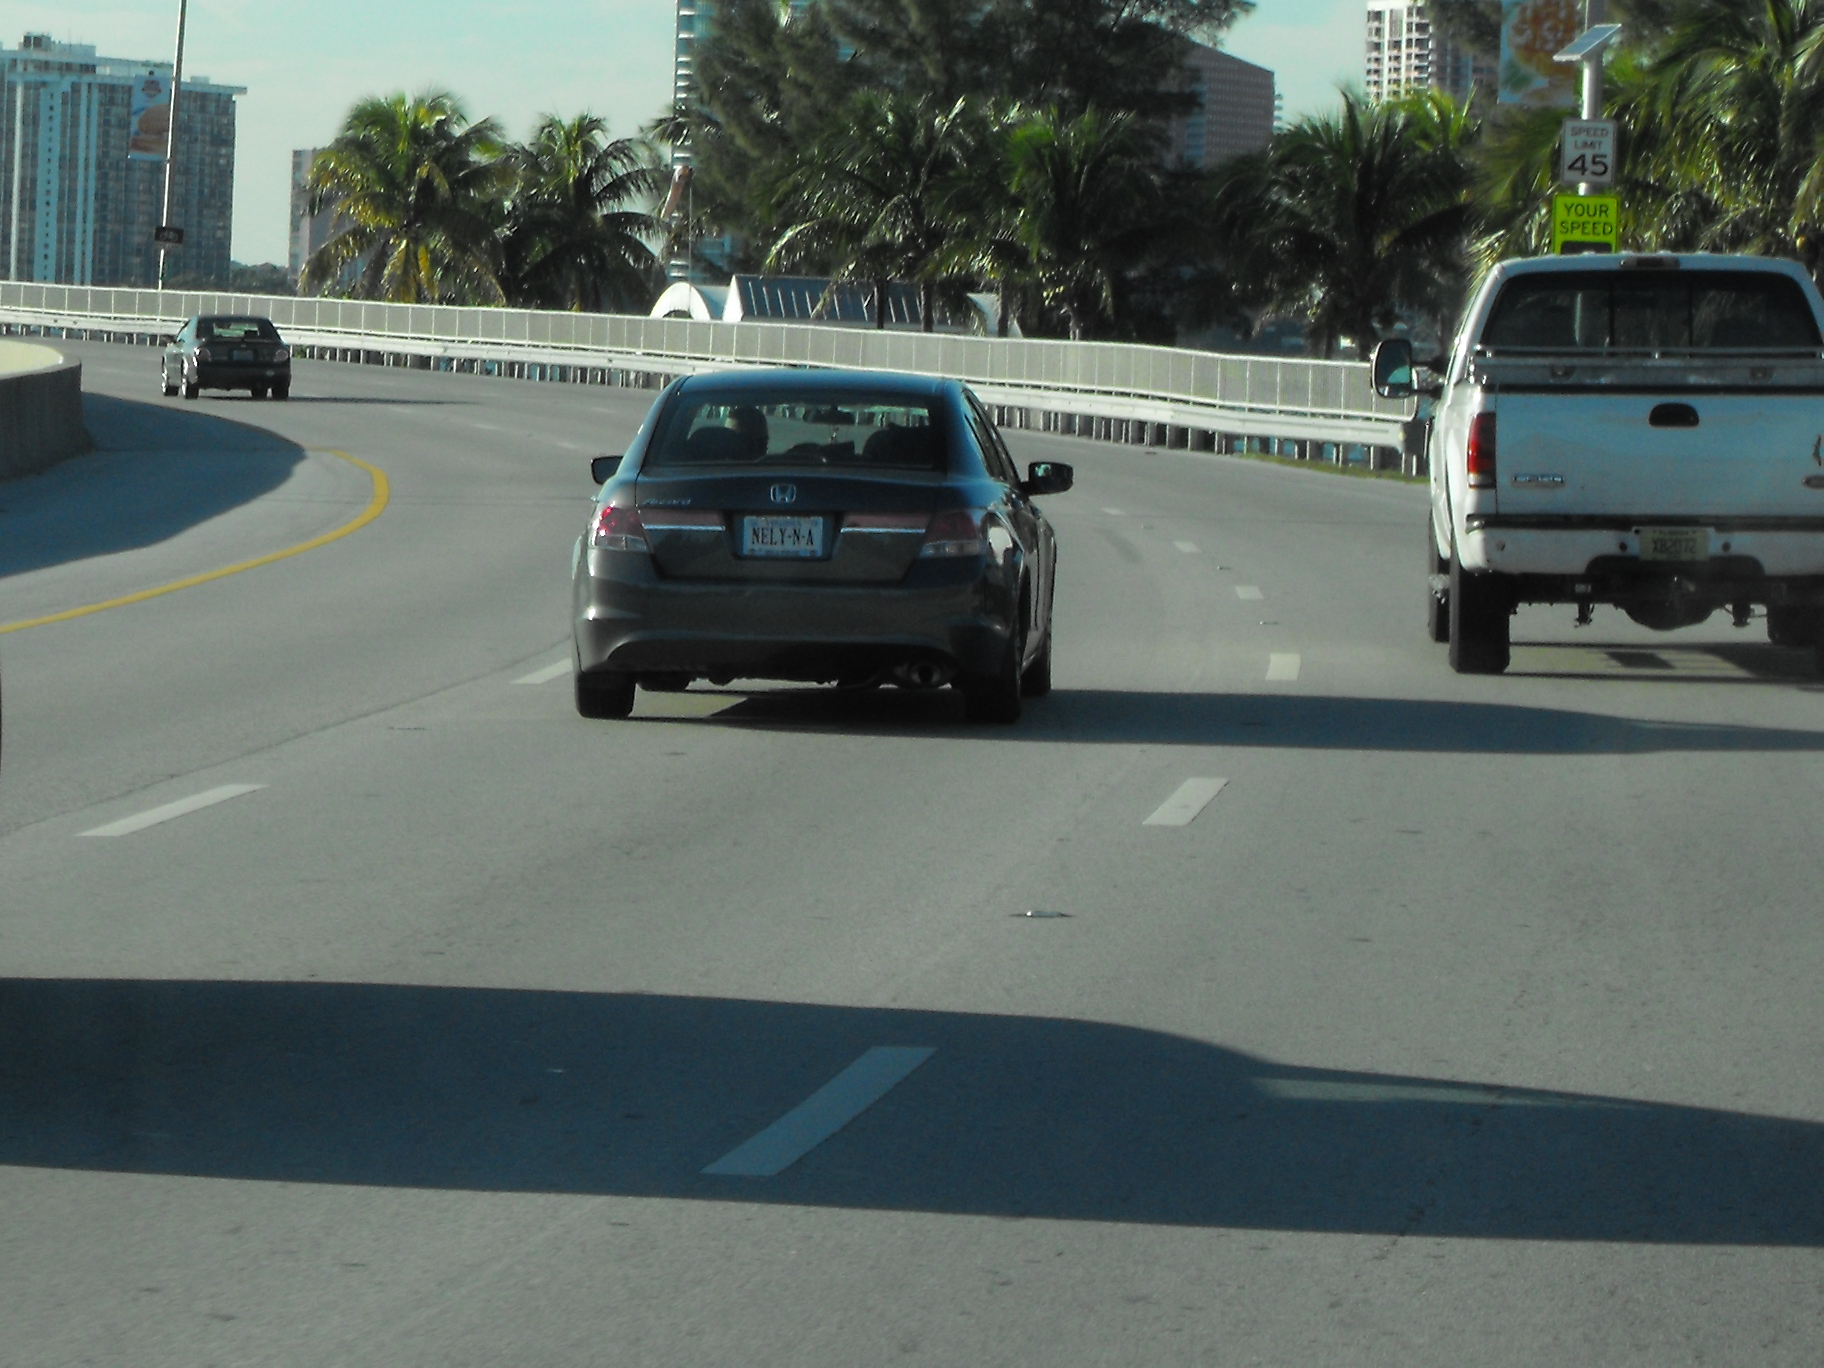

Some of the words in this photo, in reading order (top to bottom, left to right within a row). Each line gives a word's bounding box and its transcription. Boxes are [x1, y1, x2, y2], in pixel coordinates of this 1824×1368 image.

[1570, 125, 1609, 137] SPEED
[1574, 140, 1603, 150] LIMIT
[1567, 153, 1609, 177] 45
[1564, 203, 1609, 218] YOUR
[1559, 220, 1613, 236] SPEED
